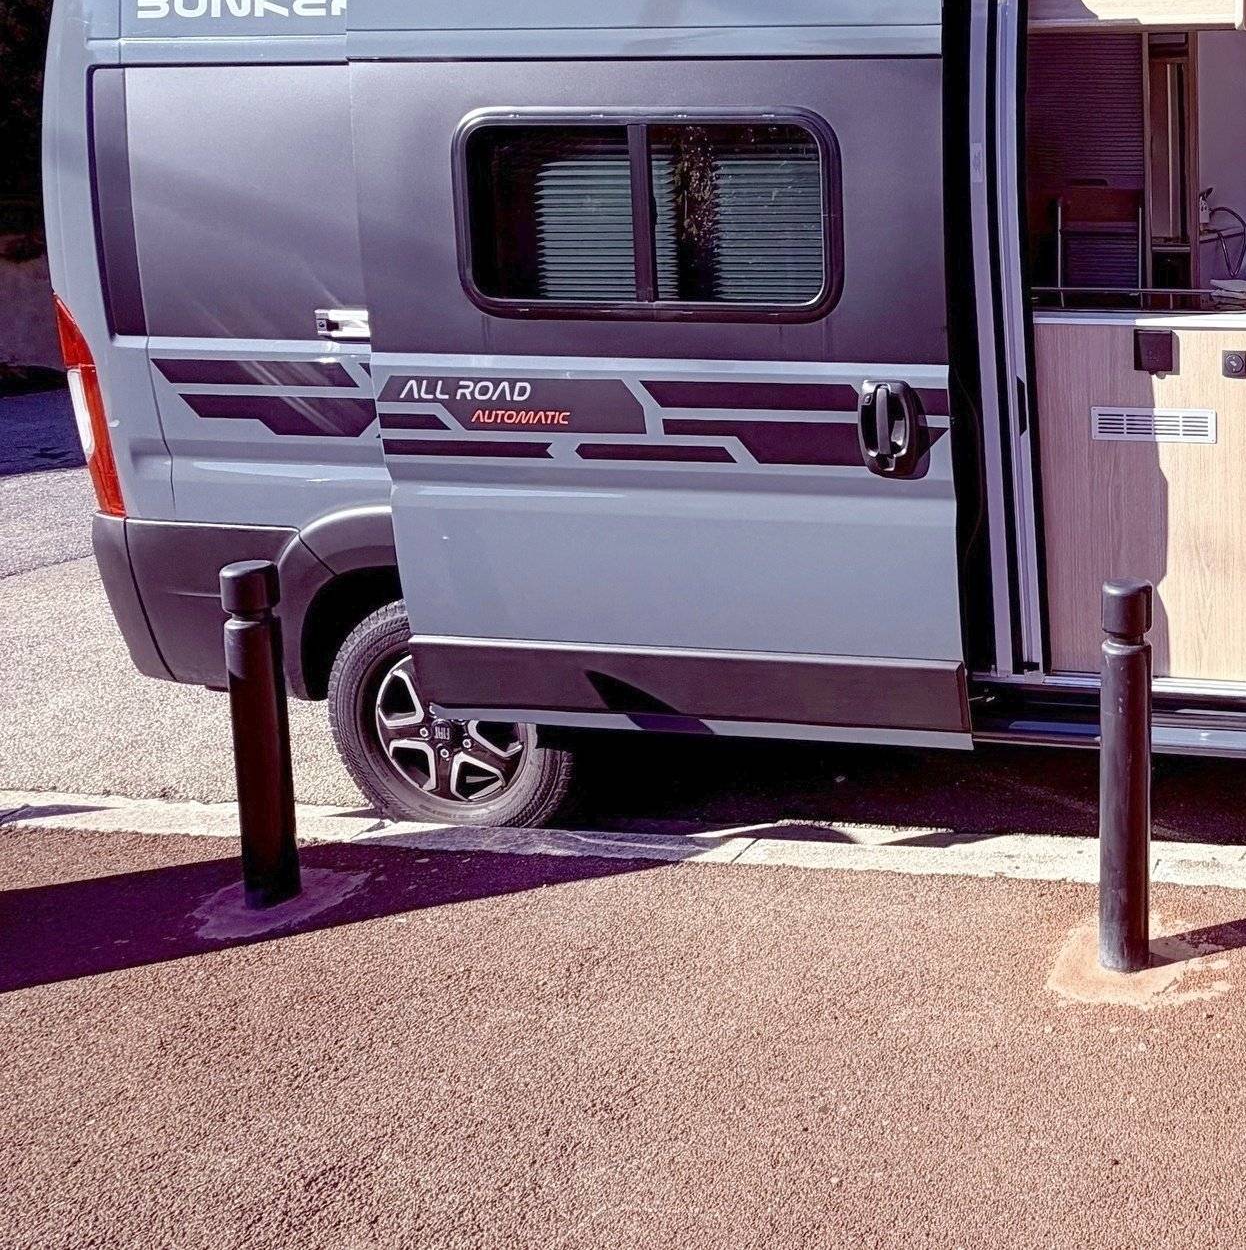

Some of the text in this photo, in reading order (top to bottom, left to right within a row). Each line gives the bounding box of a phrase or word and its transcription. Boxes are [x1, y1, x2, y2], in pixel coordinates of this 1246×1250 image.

[399, 379, 531, 401] ALL ROAD
[471, 409, 571, 425] AUTOMATIC
